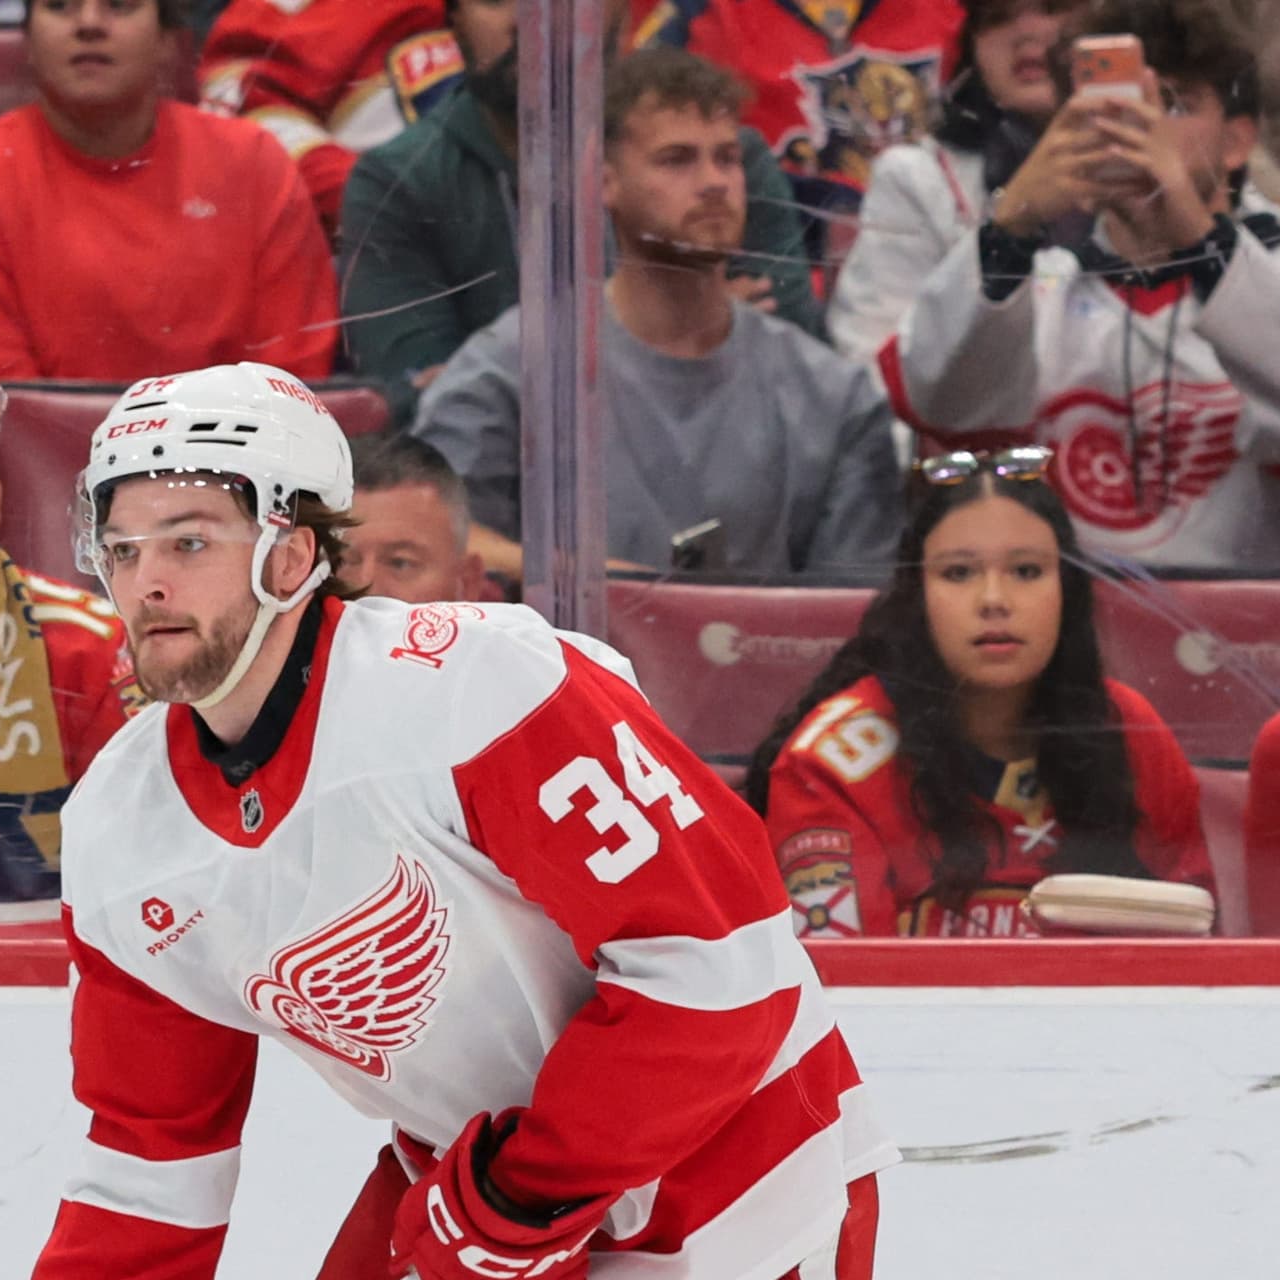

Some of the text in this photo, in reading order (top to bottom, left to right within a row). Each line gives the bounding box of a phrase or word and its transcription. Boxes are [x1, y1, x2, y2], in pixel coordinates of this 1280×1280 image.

[107, 418, 169, 440] CCM
[538, 719, 705, 884] 34
[146, 909, 206, 957] PRIORITY
